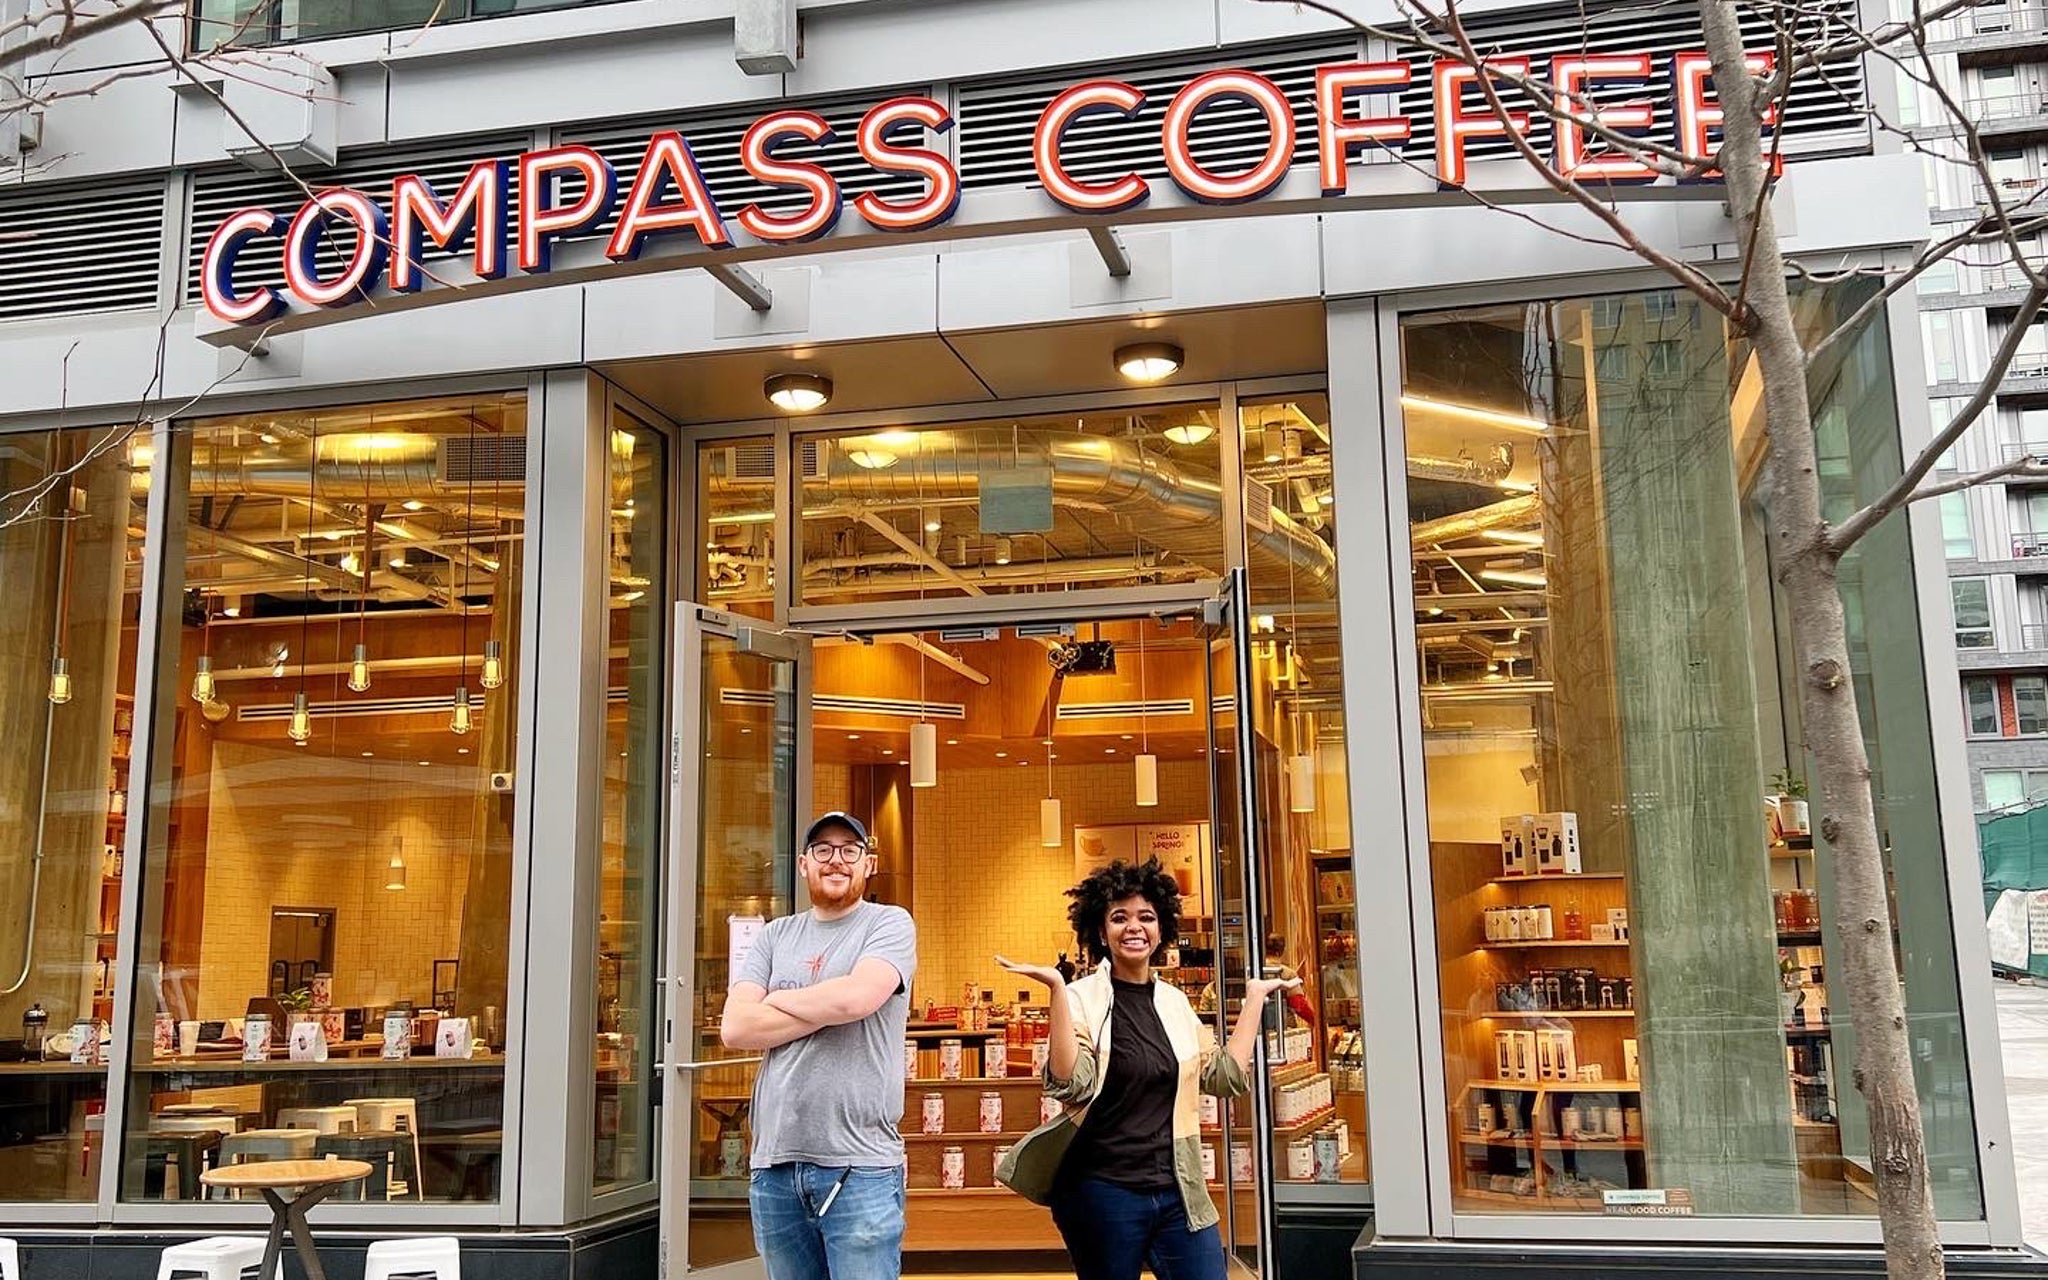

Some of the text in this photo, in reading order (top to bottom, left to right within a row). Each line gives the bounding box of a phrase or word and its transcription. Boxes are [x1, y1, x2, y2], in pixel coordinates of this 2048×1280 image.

[200, 50, 1784, 326] COMPASS COFFEE
[1156, 831, 1180, 840] HELLO
[1629, 1206, 1656, 1215] GOOD
[1658, 1206, 1692, 1215] COFFEE
